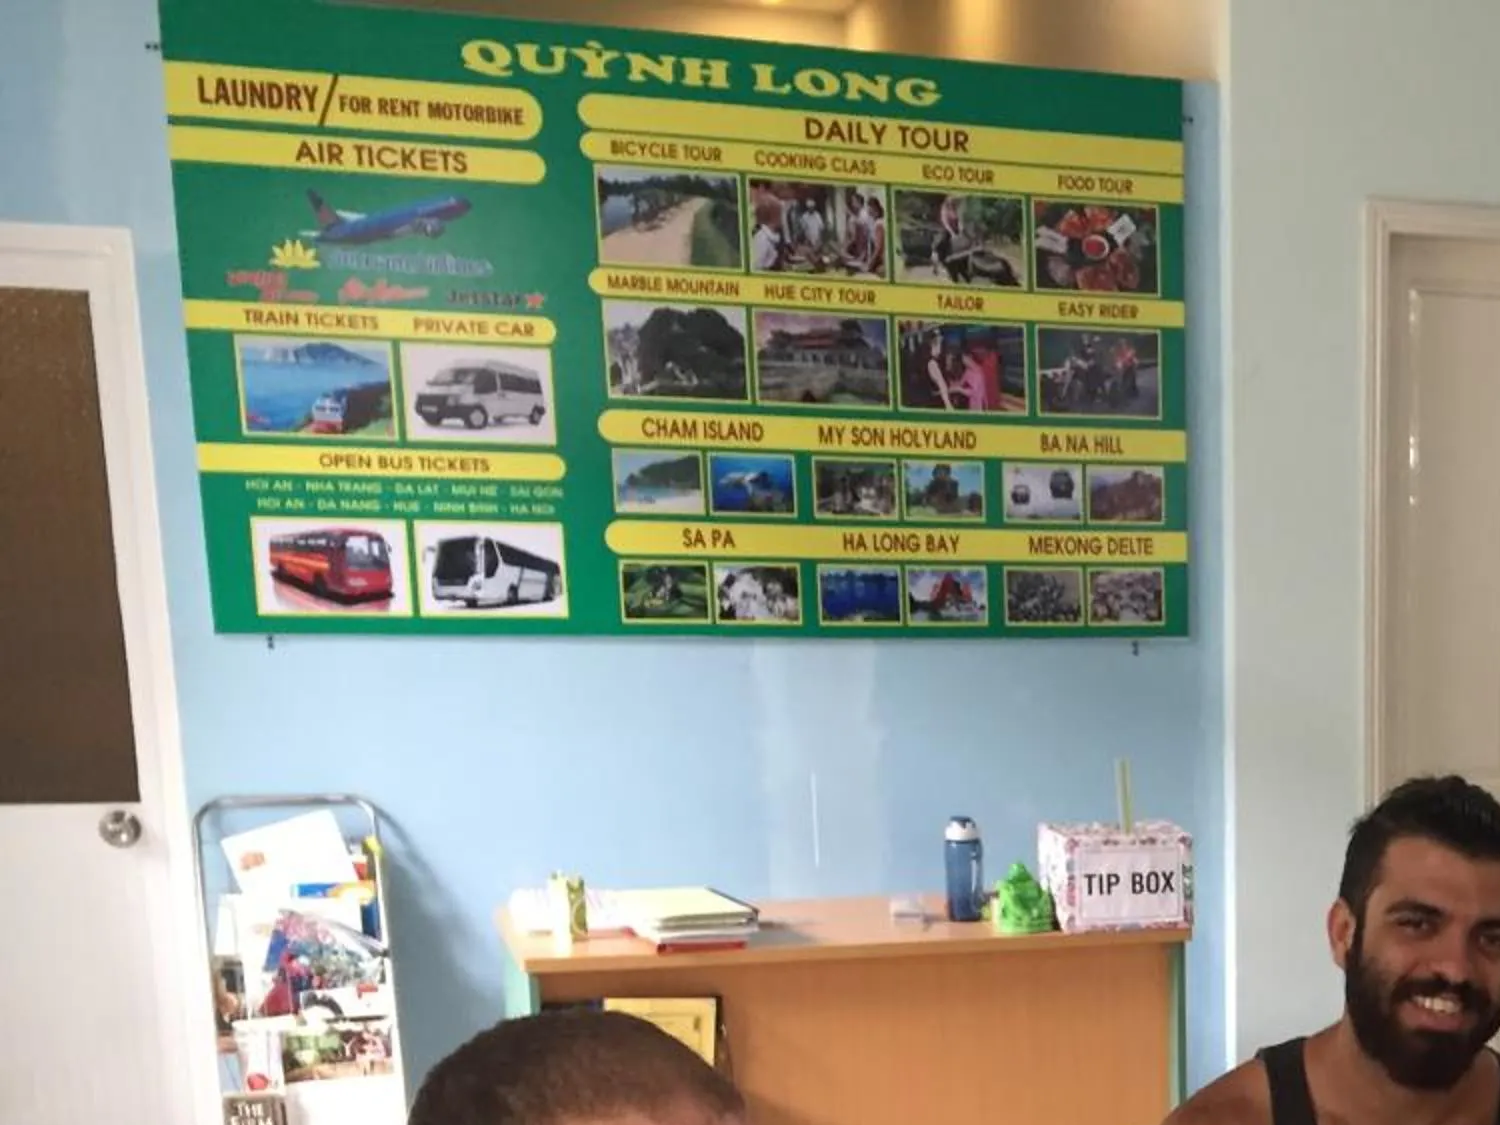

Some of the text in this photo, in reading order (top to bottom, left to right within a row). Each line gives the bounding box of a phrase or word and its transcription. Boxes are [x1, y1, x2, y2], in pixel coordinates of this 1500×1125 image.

[460, 39, 943, 107] QUỲNH LONG
[339, 93, 372, 115] FOR
[378, 98, 421, 118] RENT
[427, 102, 525, 126] MOTORBIKE
[805, 117, 970, 152] DAILY TOUR
[295, 141, 469, 174] AIR TICKETS
[610, 139, 722, 162] BICYCLE TOUR
[754, 150, 877, 175] COOKING CLASS
[922, 164, 995, 185] ECO TOUR
[1058, 174, 1134, 194] FOOD TOUR
[607, 275, 740, 297] MARBLE MOUNTAIN
[764, 284, 876, 304] HUE CITY TOUR
[937, 294, 985, 311] TAILOR
[1058, 302, 1139, 319] EASY RIDER
[242, 308, 379, 331] TRAIN TICKETS
[413, 316, 535, 336] PRIVATE CAR
[641, 417, 764, 442] CHAM ISLAND
[818, 424, 977, 450] MY SON HOLYLAND
[1040, 432, 1124, 454] BA NA HILL
[319, 453, 490, 473] OPEN BUS TICKETS
[682, 527, 736, 549] SA PA
[842, 532, 961, 553] HA LONG BAY
[1028, 535, 1154, 556] MEKONG DELTE
[1083, 870, 1175, 896] TIP BOX
